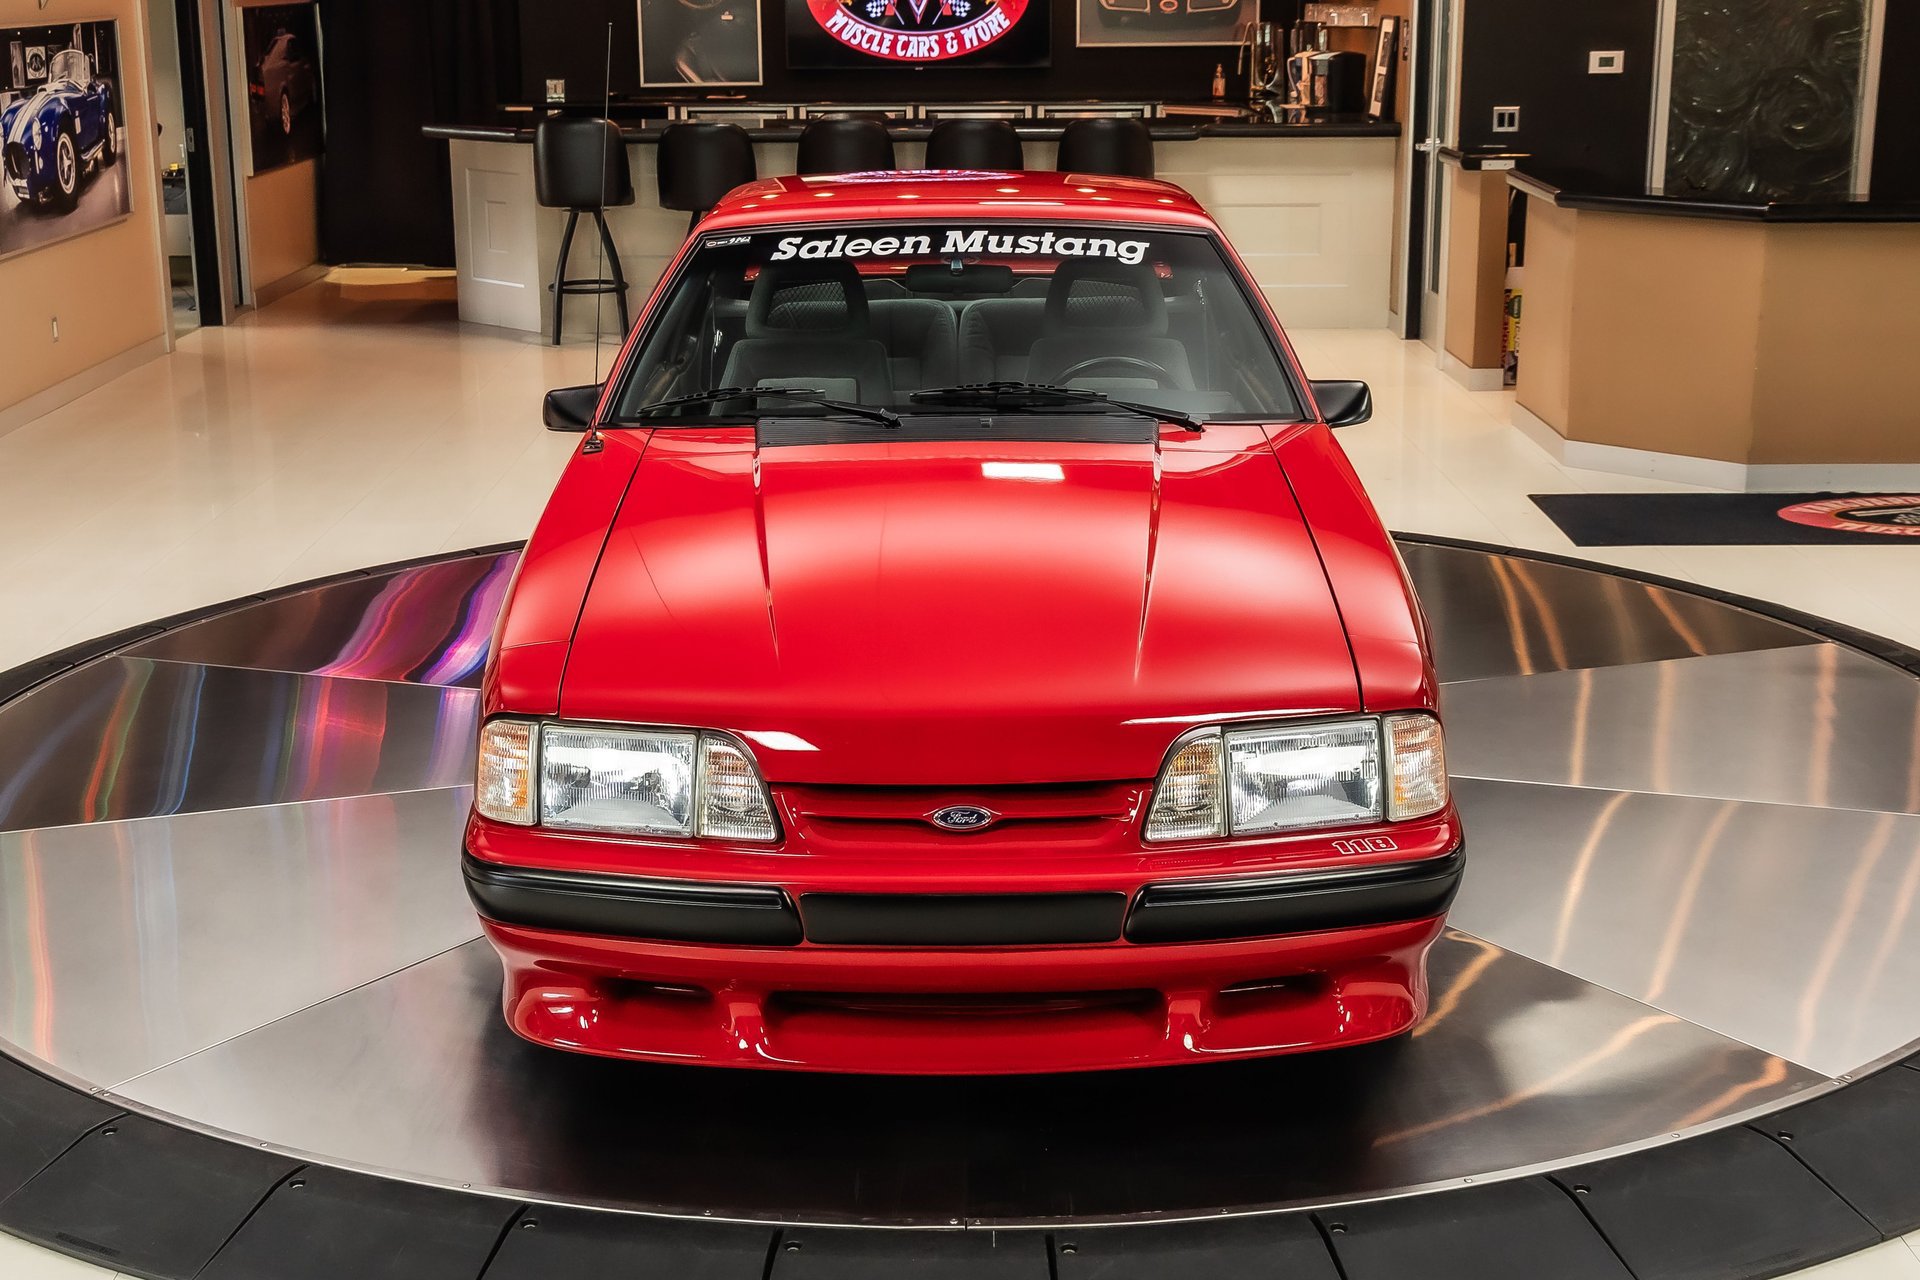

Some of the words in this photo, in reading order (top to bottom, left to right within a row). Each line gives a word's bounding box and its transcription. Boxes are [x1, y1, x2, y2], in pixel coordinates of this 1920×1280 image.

[825, 10, 894, 55] MUSCLE
[896, 34, 940, 58] CARS
[944, 34, 959, 55] &
[962, 7, 1011, 49] MORE
[770, 232, 931, 261] Saleen
[939, 230, 1150, 265] Mustang
[947, 811, 978, 824] Ford
[1332, 836, 1398, 855] 118
